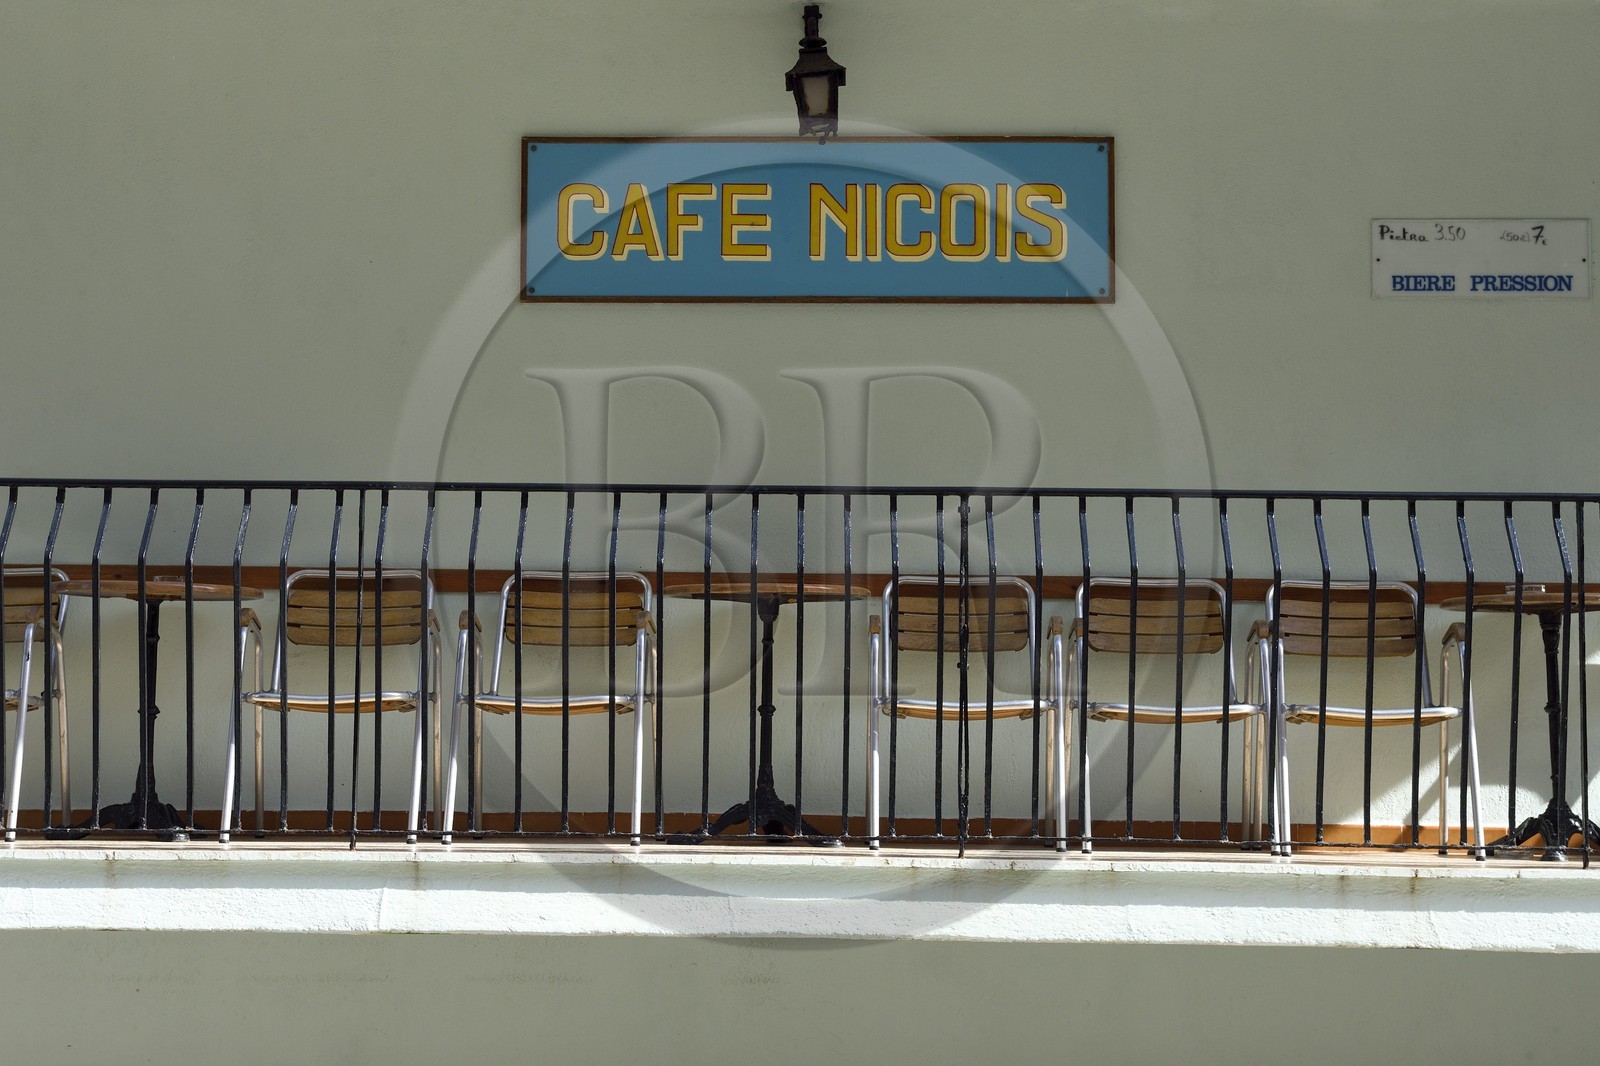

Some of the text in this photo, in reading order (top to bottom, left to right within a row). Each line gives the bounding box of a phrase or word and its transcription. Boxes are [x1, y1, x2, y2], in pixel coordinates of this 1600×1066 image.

[556, 183, 1068, 262] CAFE NICOIS
[1392, 275, 1573, 292] BIERE PRESSION
